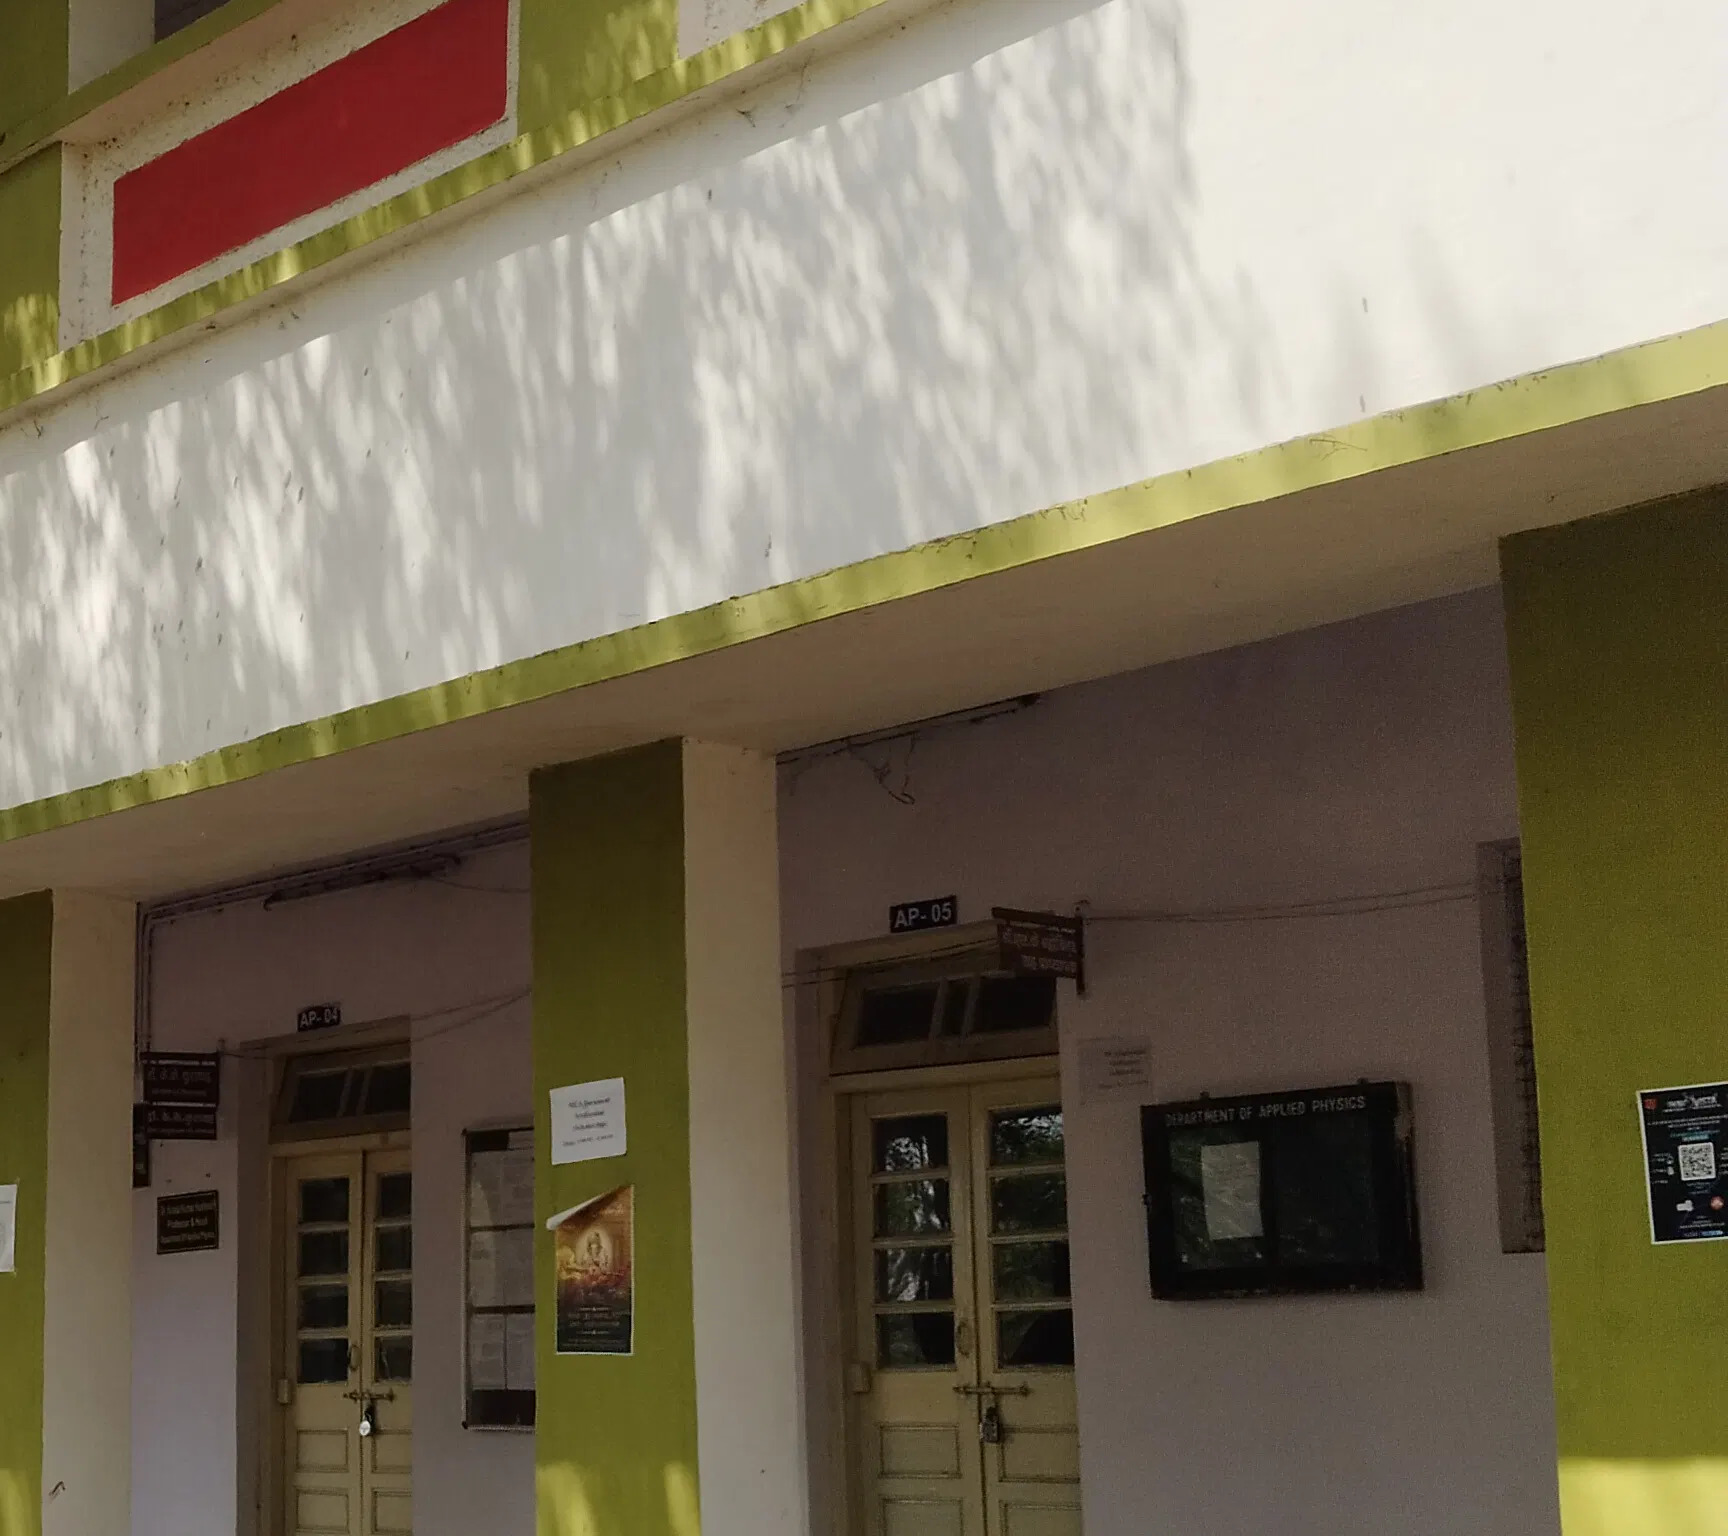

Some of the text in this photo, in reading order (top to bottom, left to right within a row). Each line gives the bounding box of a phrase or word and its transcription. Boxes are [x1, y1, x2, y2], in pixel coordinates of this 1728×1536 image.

[1165, 1096, 1366, 1128] DEPARTMENT OF APPLIED PHYSICS
